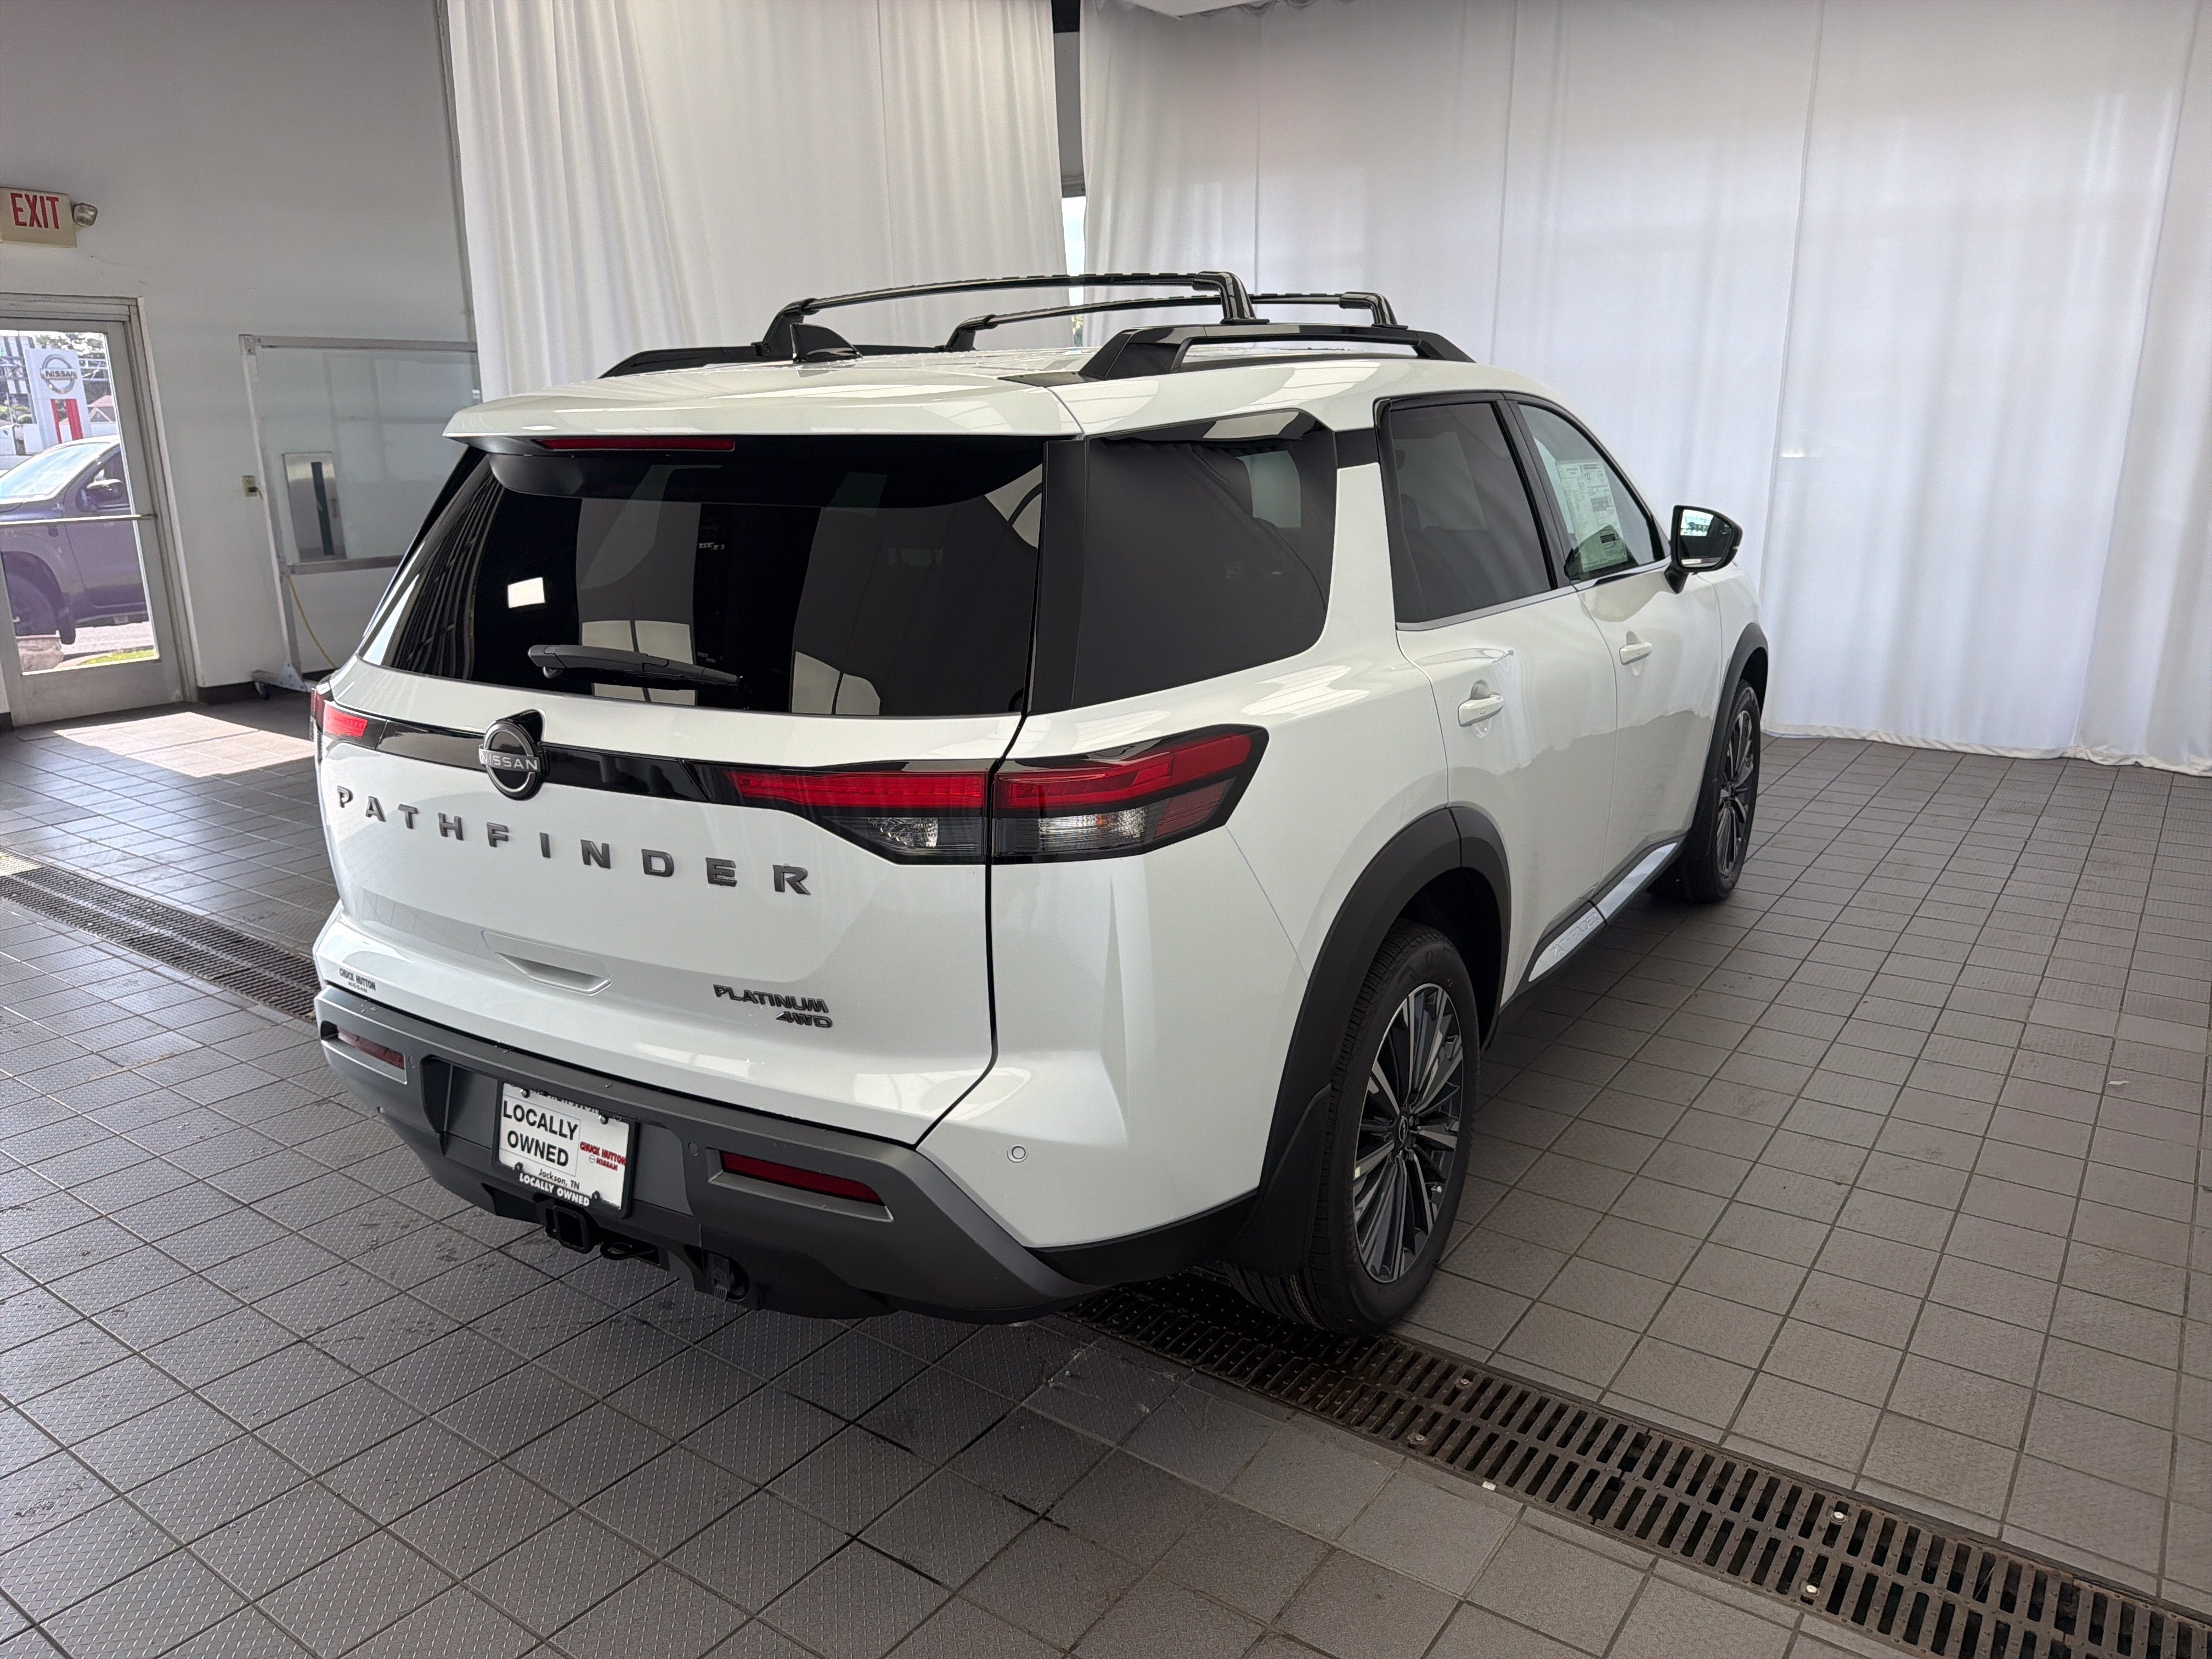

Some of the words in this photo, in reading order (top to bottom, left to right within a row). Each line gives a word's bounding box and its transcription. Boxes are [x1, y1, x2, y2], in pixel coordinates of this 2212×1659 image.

[10, 193, 60, 229] EXIT
[479, 750, 538, 771] NISSAN
[336, 785, 811, 895] PATHFINDER
[339, 967, 354, 981] CHUCK
[356, 974, 376, 991] HUTTON
[348, 981, 368, 992] NISSAN
[713, 984, 830, 1013] PLATINUM
[775, 1011, 833, 1028] 4WD
[503, 1100, 579, 1141] LOCALLY
[507, 1130, 569, 1167] OWNED
[579, 1141, 600, 1156] CHUCK
[596, 1158, 618, 1171] NISSAN
[519, 1172, 555, 1195] LOCALLY
[556, 1188, 590, 1206] OWNED
[538, 1168, 568, 1187] Jackson,
[570, 1179, 580, 1190] TN
